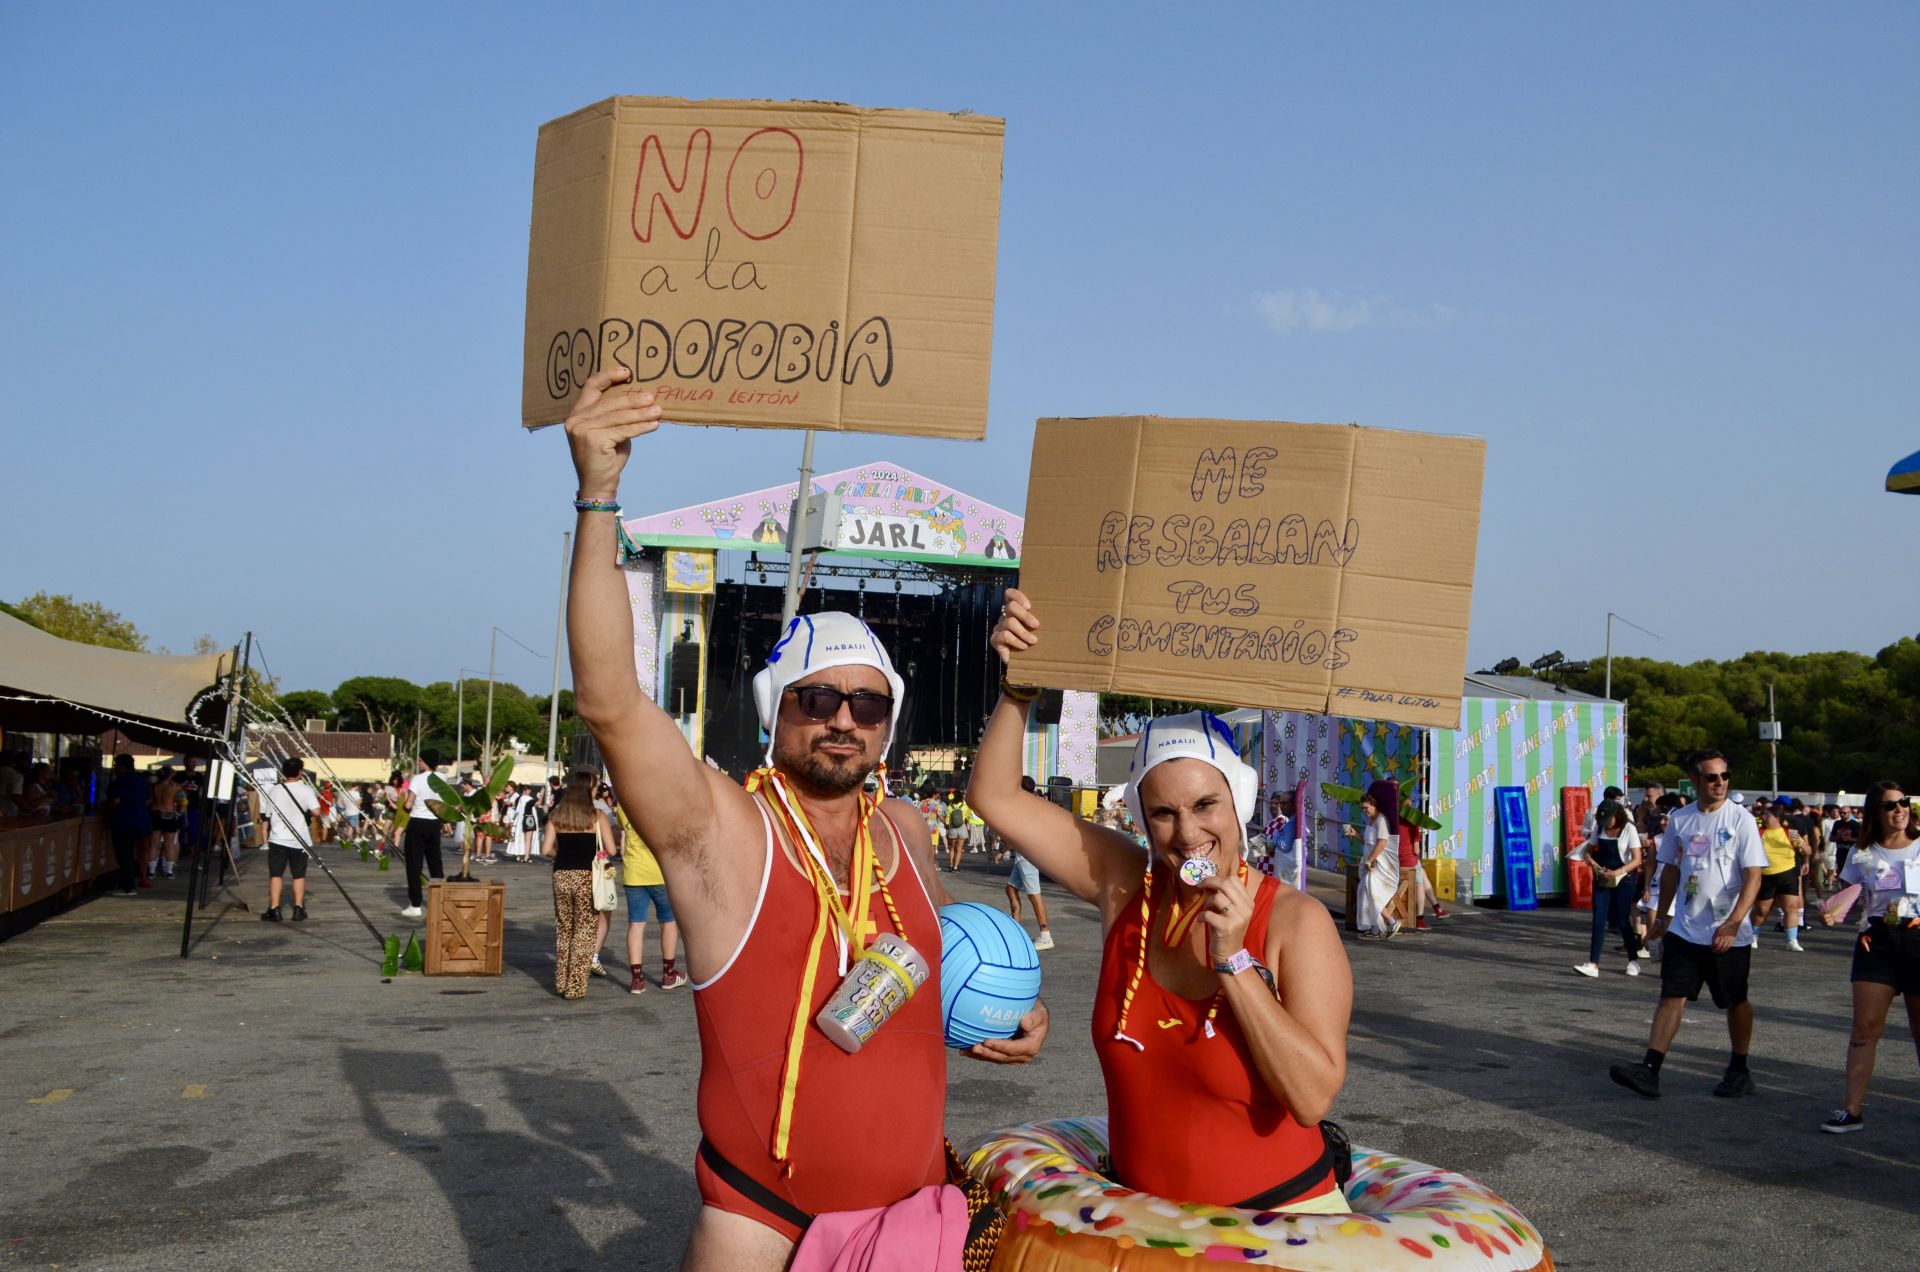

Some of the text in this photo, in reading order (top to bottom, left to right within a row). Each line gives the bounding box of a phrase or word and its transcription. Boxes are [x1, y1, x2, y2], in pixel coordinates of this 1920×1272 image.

[631, 128, 804, 243] NO
[640, 227, 768, 296] a la
[654, 385, 714, 402] PAULA
[871, 470, 898, 482] 2024
[1190, 446, 1278, 504] ME
[833, 481, 941, 505] CANELA PARTY
[822, 539, 833, 547] 44
[849, 519, 926, 550] JARL
[1097, 511, 1359, 572] RESBALAN
[1167, 580, 1260, 617] TUS
[825, 643, 866, 652] NABAIJI
[1360, 690, 1394, 704] PAULA
[1493, 702, 1523, 735] PARTY
[1551, 703, 1579, 736] PARTY
[1158, 738, 1196, 749] NABAIJI
[1464, 767, 1495, 799] PARTY
